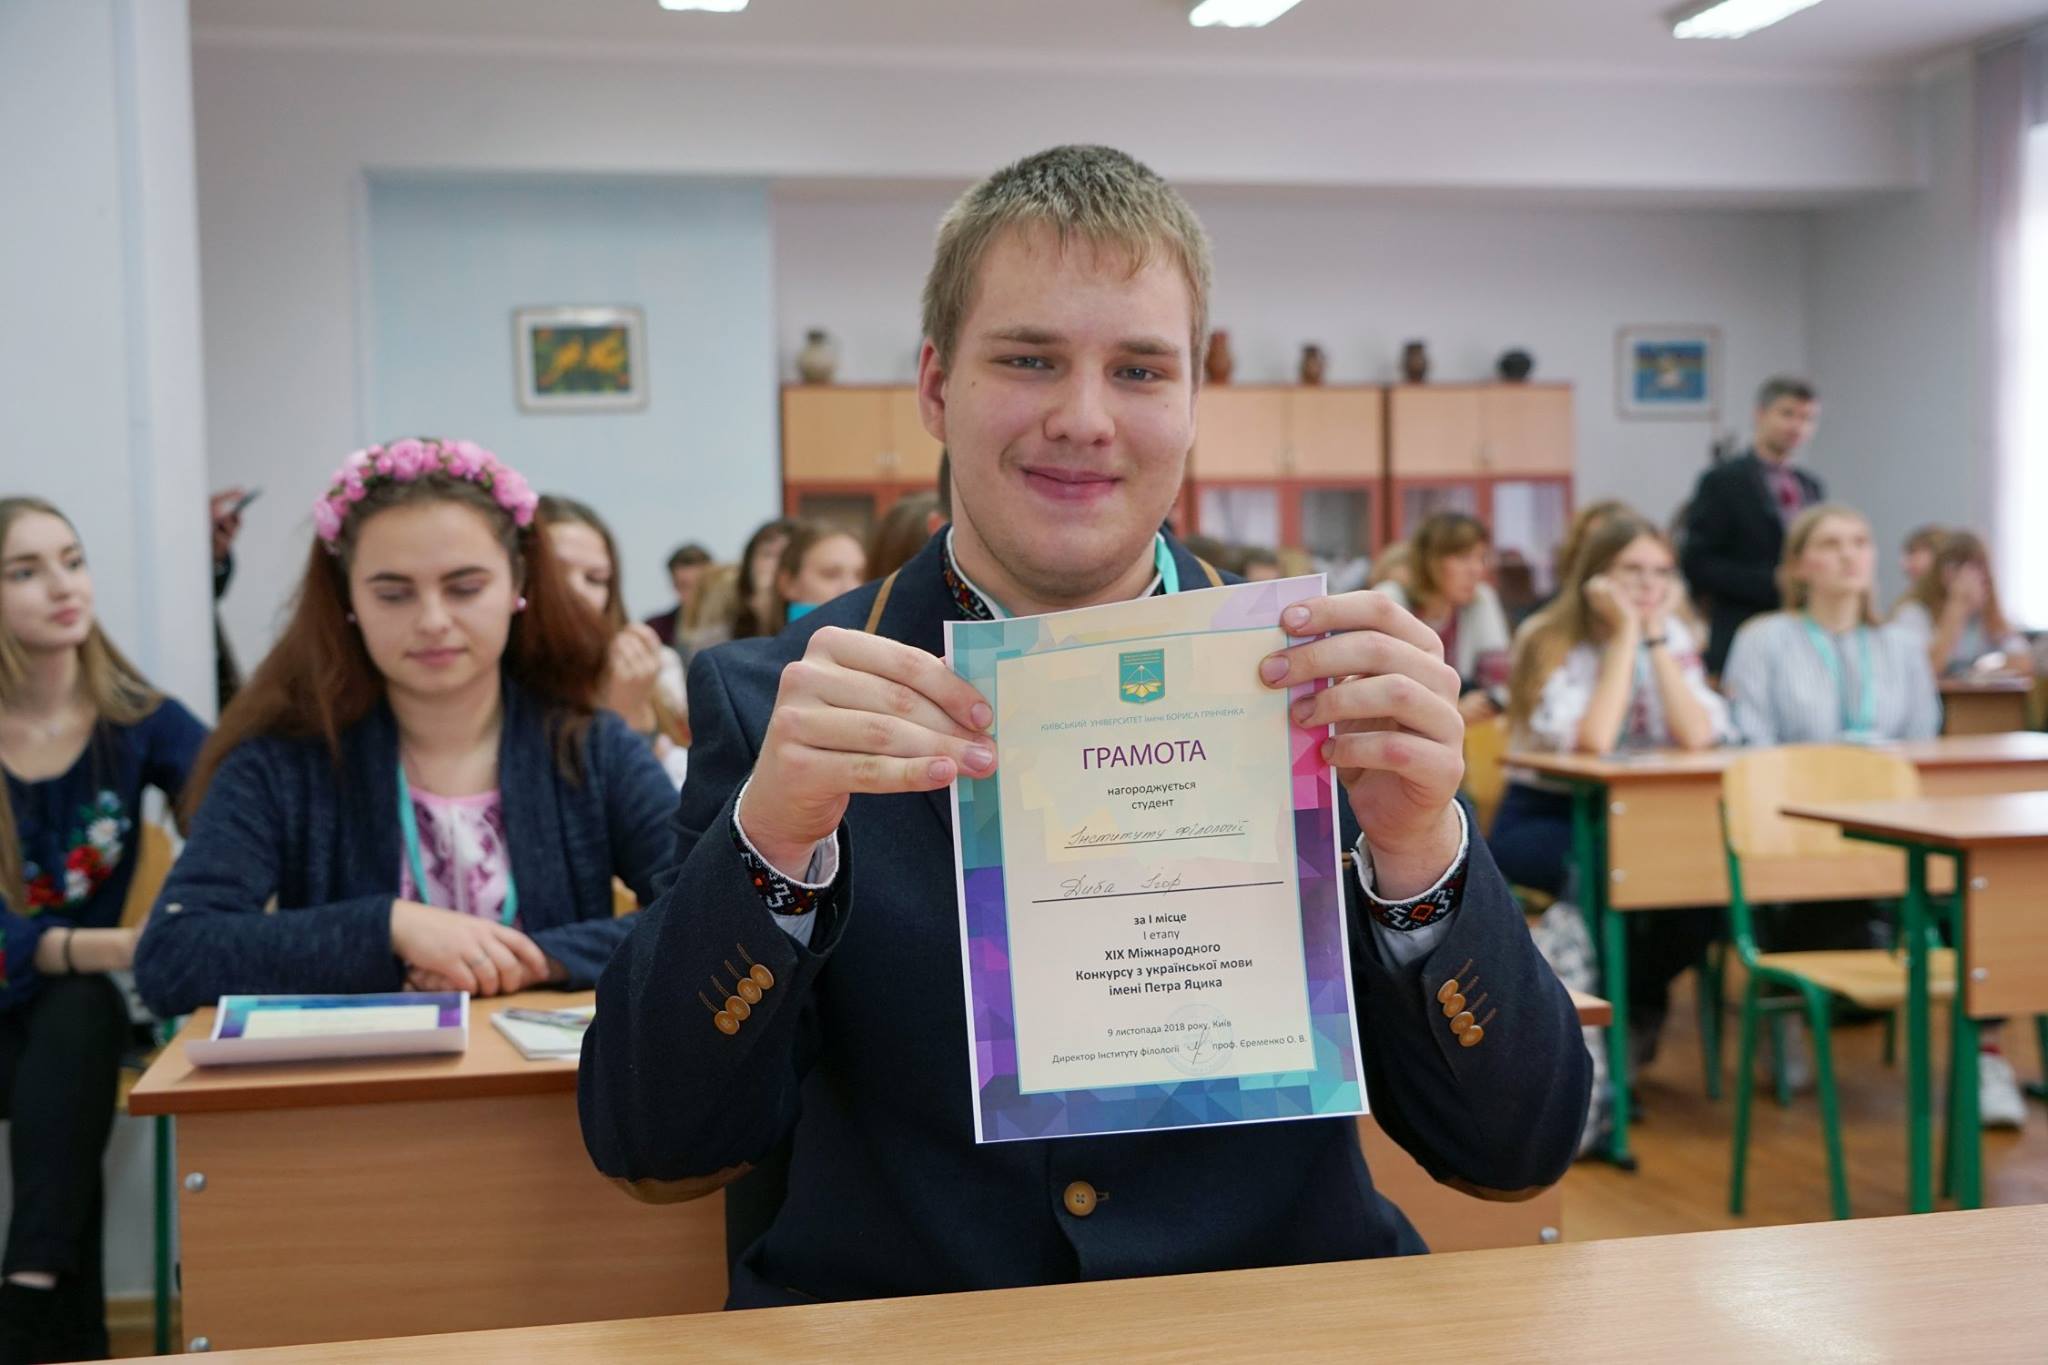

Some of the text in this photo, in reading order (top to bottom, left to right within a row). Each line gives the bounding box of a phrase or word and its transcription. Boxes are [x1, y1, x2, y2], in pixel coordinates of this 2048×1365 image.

[1090, 715, 1142, 728] УНІВЕРСИТЕТ
[1166, 711, 1199, 722] БОРИСА
[1082, 739, 1207, 770] ГРАМОТА
[1107, 780, 1197, 797] нагороджується
[1131, 798, 1175, 811] студент
[1133, 916, 1146, 926] за
[1155, 912, 1187, 924] місце
[1149, 930, 1180, 941] етапу
[1128, 943, 1221, 960] Міжнародного
[1075, 958, 1253, 981] Конкурсу з української мови
[1109, 977, 1223, 996] імені Петра Яцика
[1107, 1028, 1113, 1037] 9
[1115, 1025, 1162, 1037] листопада
[1164, 1022, 1185, 1032] 2018
[1052, 1052, 1096, 1064] Директор
[1097, 1048, 1138, 1060] Інституту
[1140, 1044, 1180, 1057] філології
[1212, 1040, 1238, 1051] проф.
[1240, 1037, 1285, 1048] Єременко
